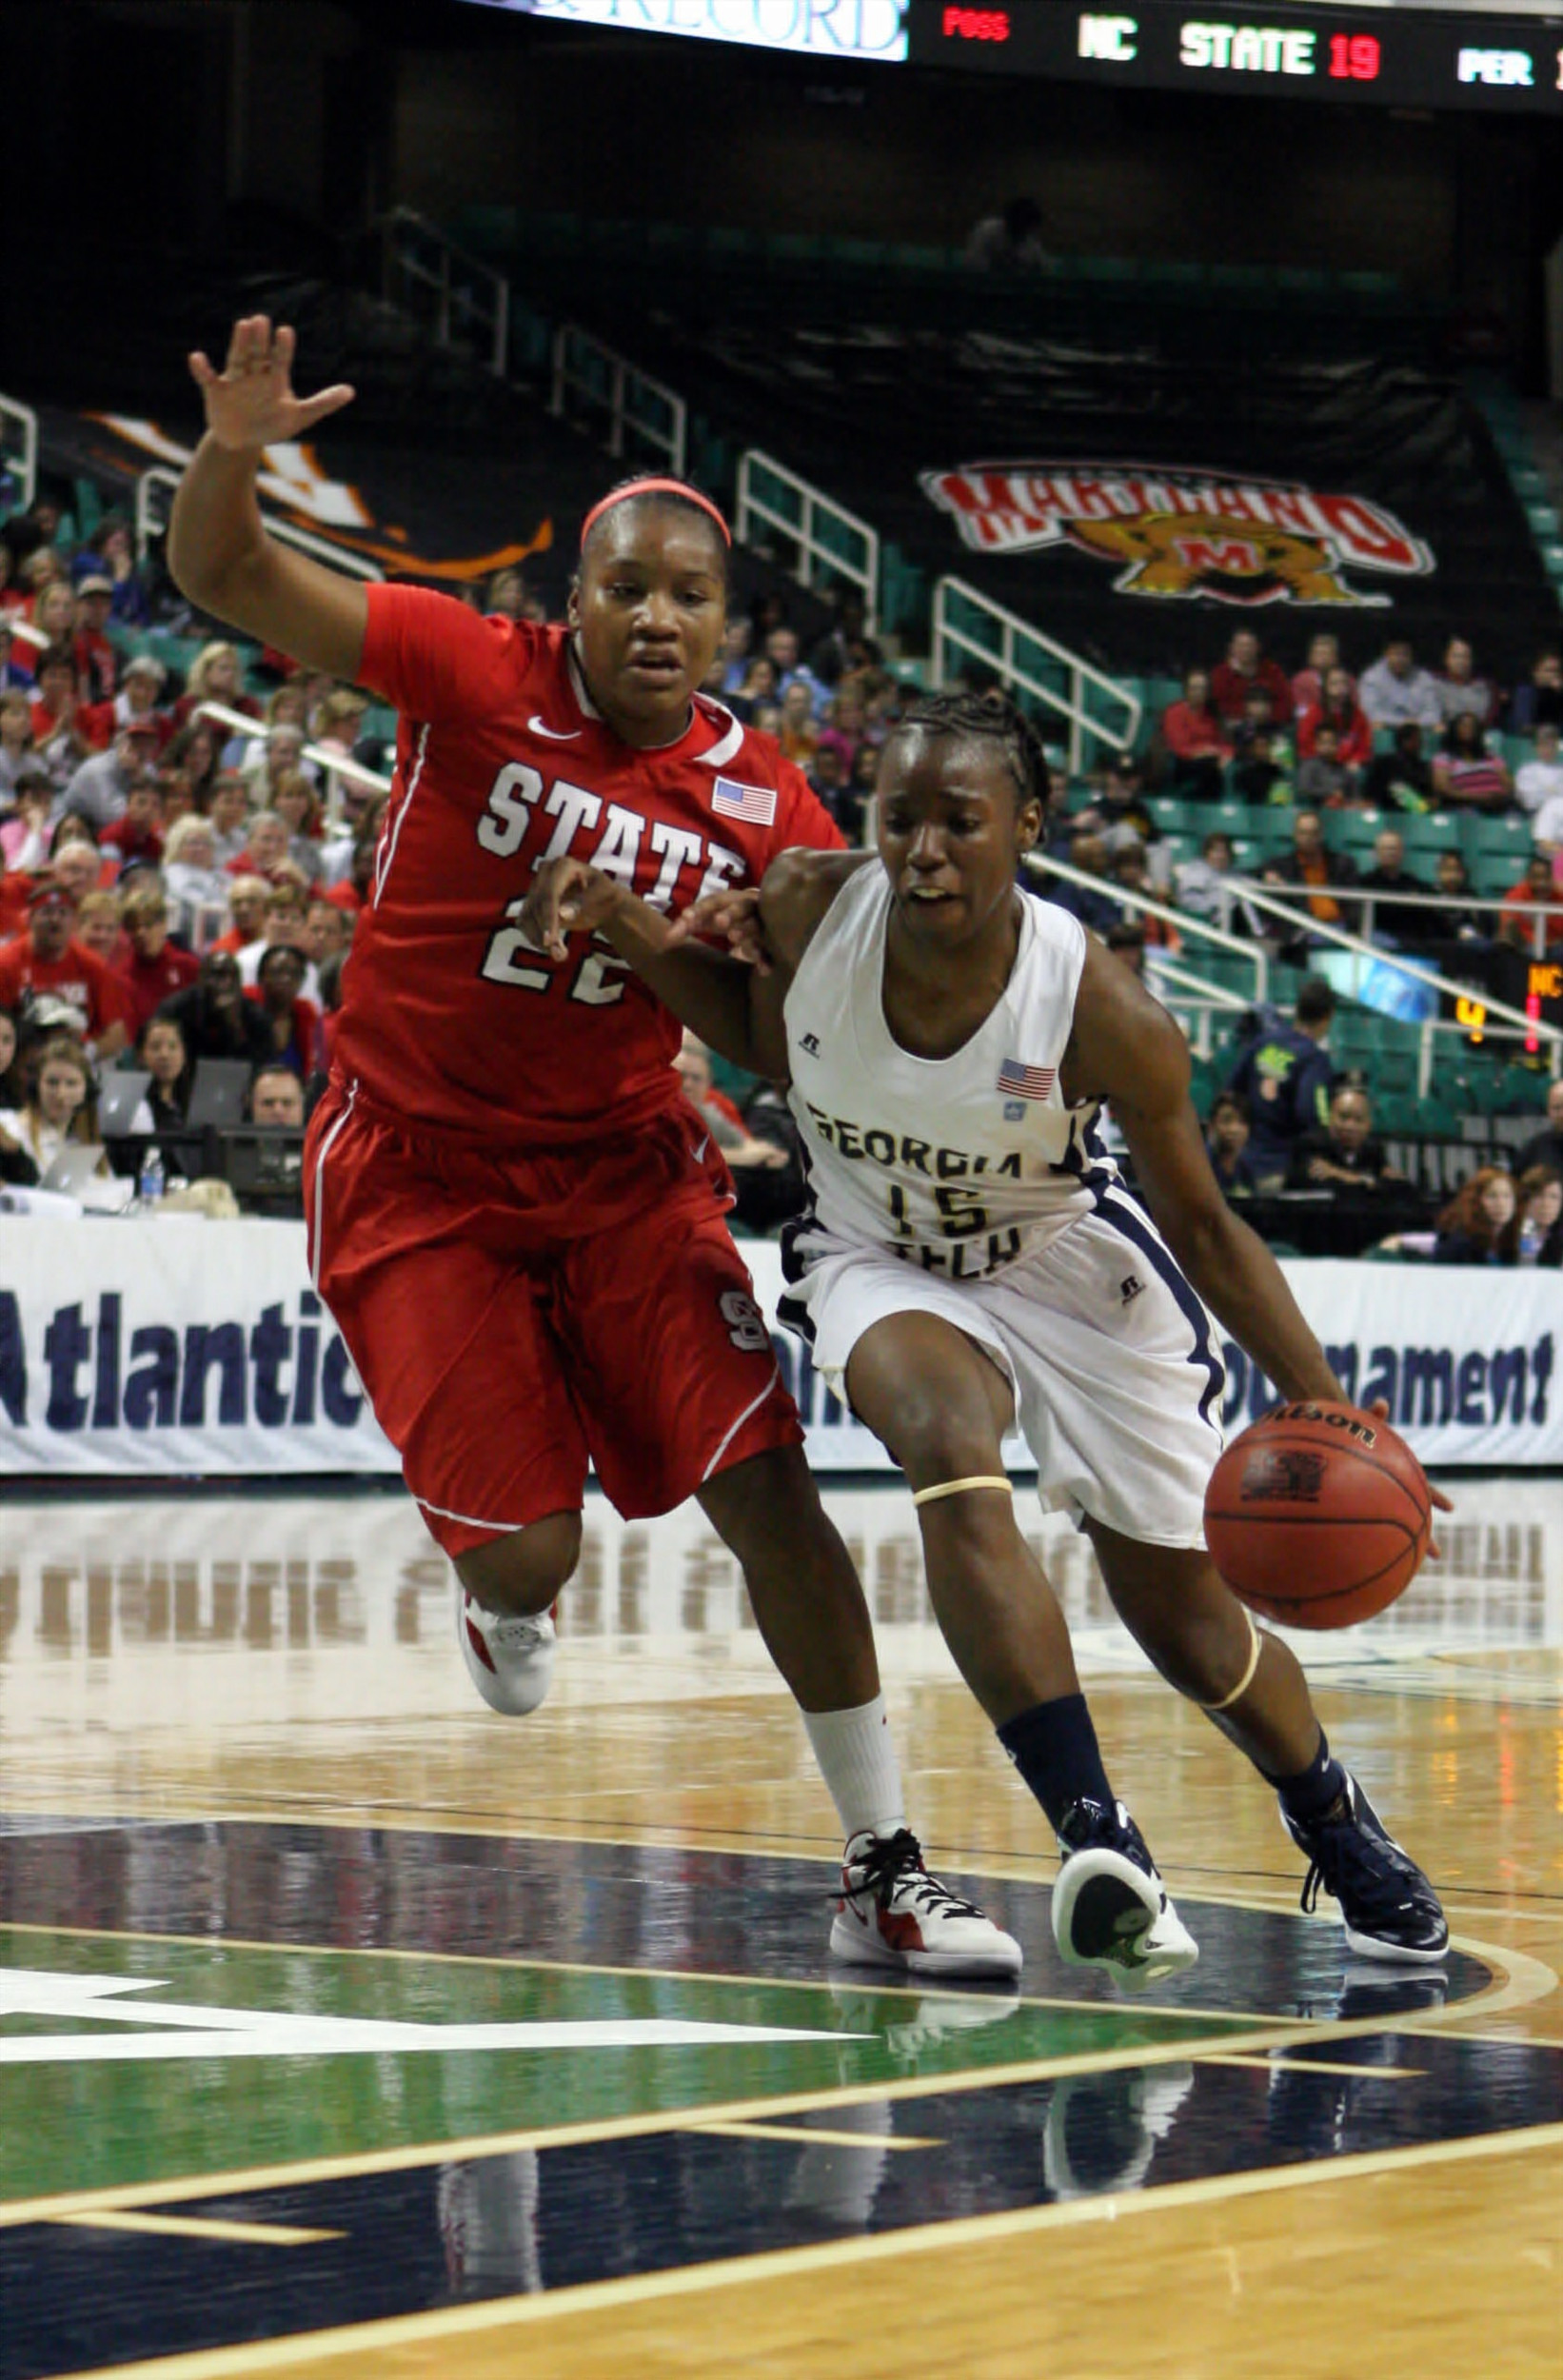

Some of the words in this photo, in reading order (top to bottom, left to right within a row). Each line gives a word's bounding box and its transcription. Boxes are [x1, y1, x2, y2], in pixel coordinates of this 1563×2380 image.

[942, 9, 1009, 41] POSS
[1078, 14, 1138, 60] NC
[1179, 22, 1316, 75] STATE
[1329, 34, 1381, 80] 19
[1456, 48, 1534, 87] PER
[1222, 1330, 1553, 1428] ounament
